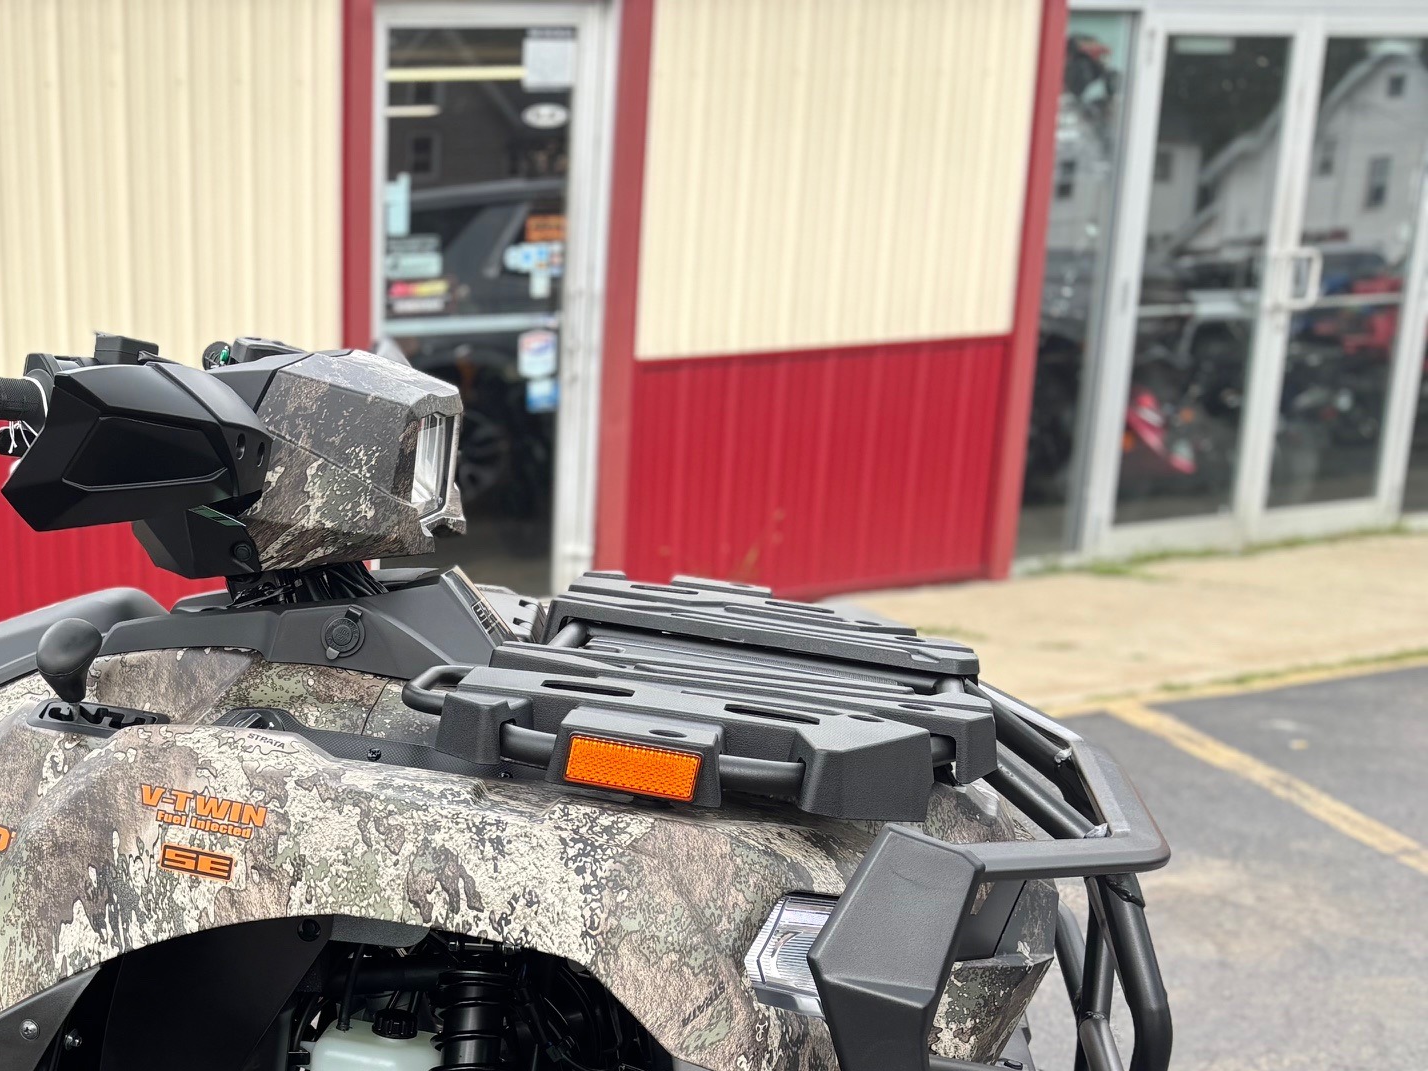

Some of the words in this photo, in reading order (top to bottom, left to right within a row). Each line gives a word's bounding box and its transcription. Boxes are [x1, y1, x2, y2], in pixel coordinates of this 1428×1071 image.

[247, 732, 285, 750] STRATA
[140, 783, 268, 828] V-TWIN
[155, 808, 188, 827] Fuel
[189, 815, 254, 840] Injected
[162, 846, 233, 879] SE
